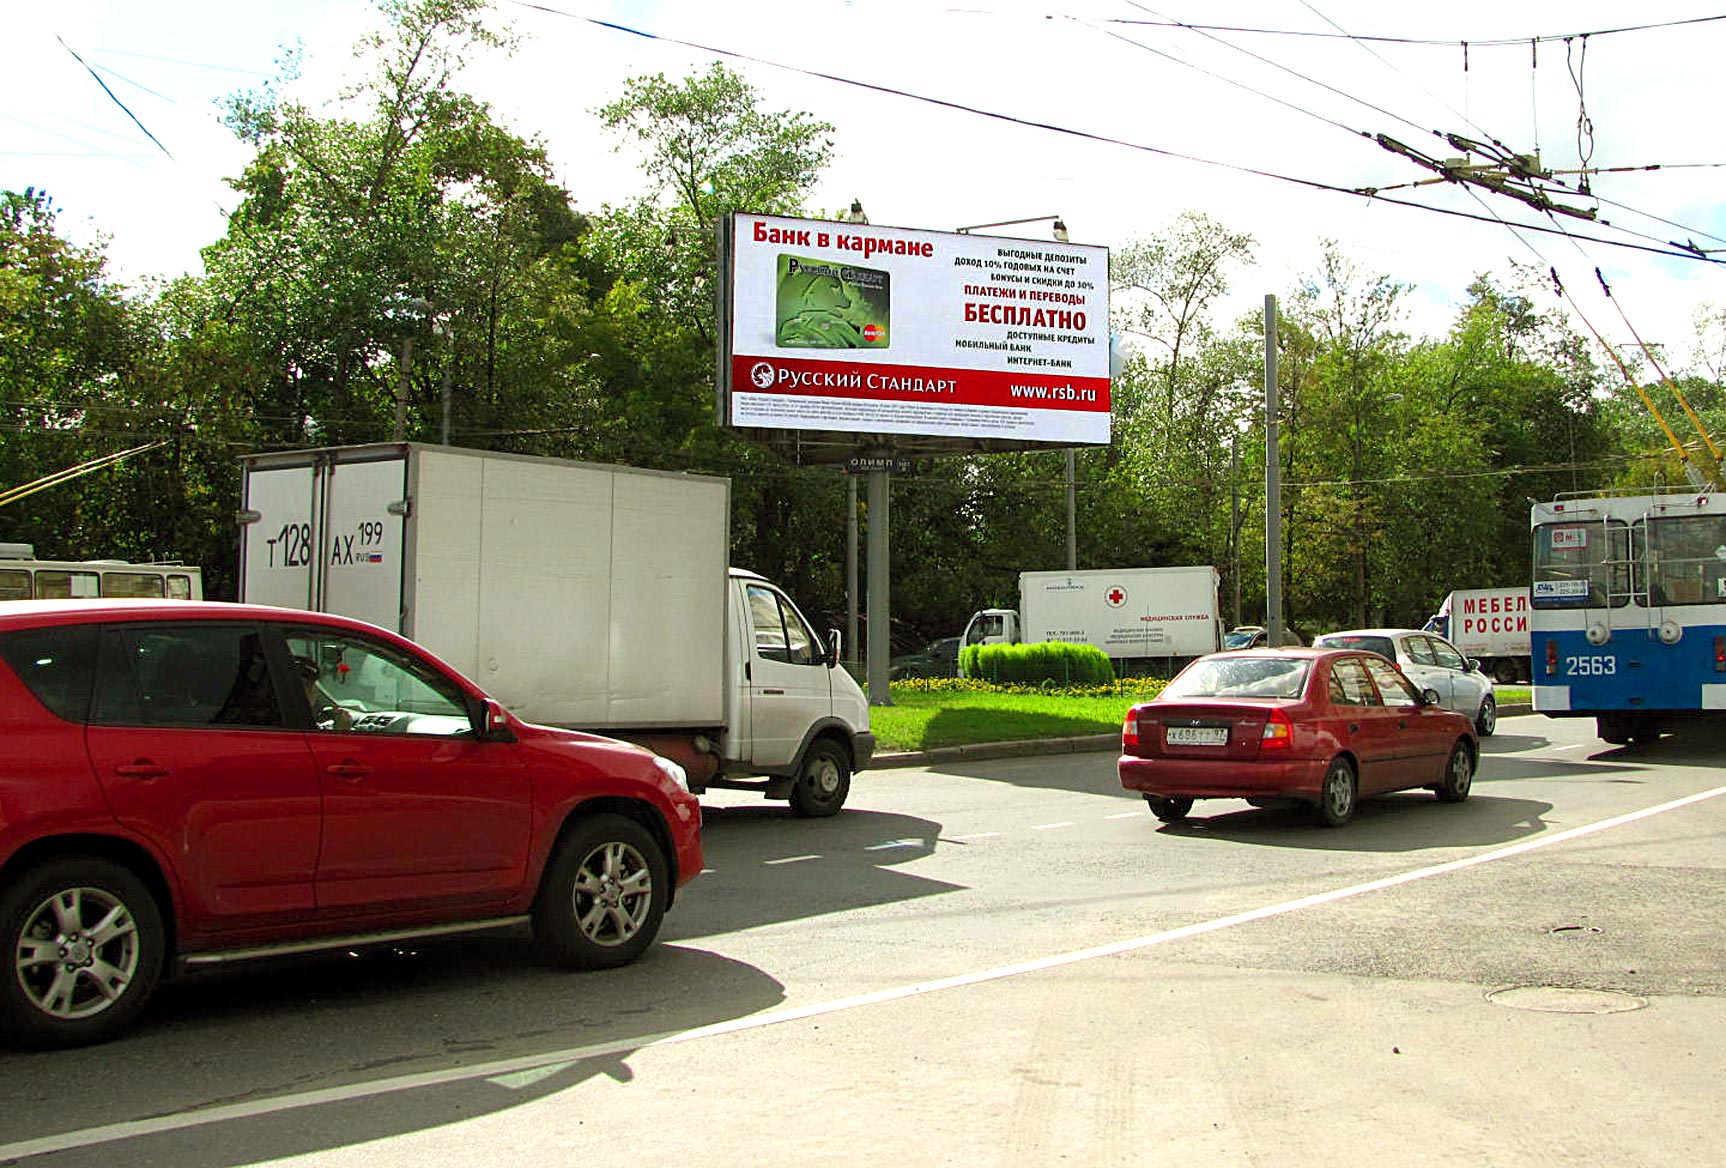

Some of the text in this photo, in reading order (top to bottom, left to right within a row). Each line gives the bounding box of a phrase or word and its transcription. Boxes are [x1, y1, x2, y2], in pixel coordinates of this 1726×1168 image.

[753, 221, 934, 259] Банк в кармане
[997, 248, 1087, 265] ВЫГОДНЫЕ ДЕПОЗИТЫ
[954, 257, 1075, 276] ДОХОД 10% ГОДОВЫХ НА СЧЕТ
[990, 273, 1023, 284] БОНУСЫ
[1024, 275, 1030, 284] И
[1031, 276, 1063, 288] СКИДКИ
[1064, 279, 1075, 289] ДО
[964, 285, 1086, 306] ПЛАТЕЖИ И ПЕРЕВОДЫ
[964, 303, 1087, 331] БЕСПЛАТНО
[955, 339, 1032, 353] МОБИЛЬНЫЙ БАНК
[1006, 331, 1095, 345] ДОСТУПНЫЕ КРЕДИТЫ
[1007, 356, 1073, 369] ИНТЕРНЕТ-БАНК
[1010, 383, 1096, 402] www.rsb.ru
[358, 521, 383, 546] 199
[1464, 596, 1527, 615] МЕБЕЛ
[1464, 616, 1527, 634] РОССИ
[1566, 655, 1616, 676] 2563
